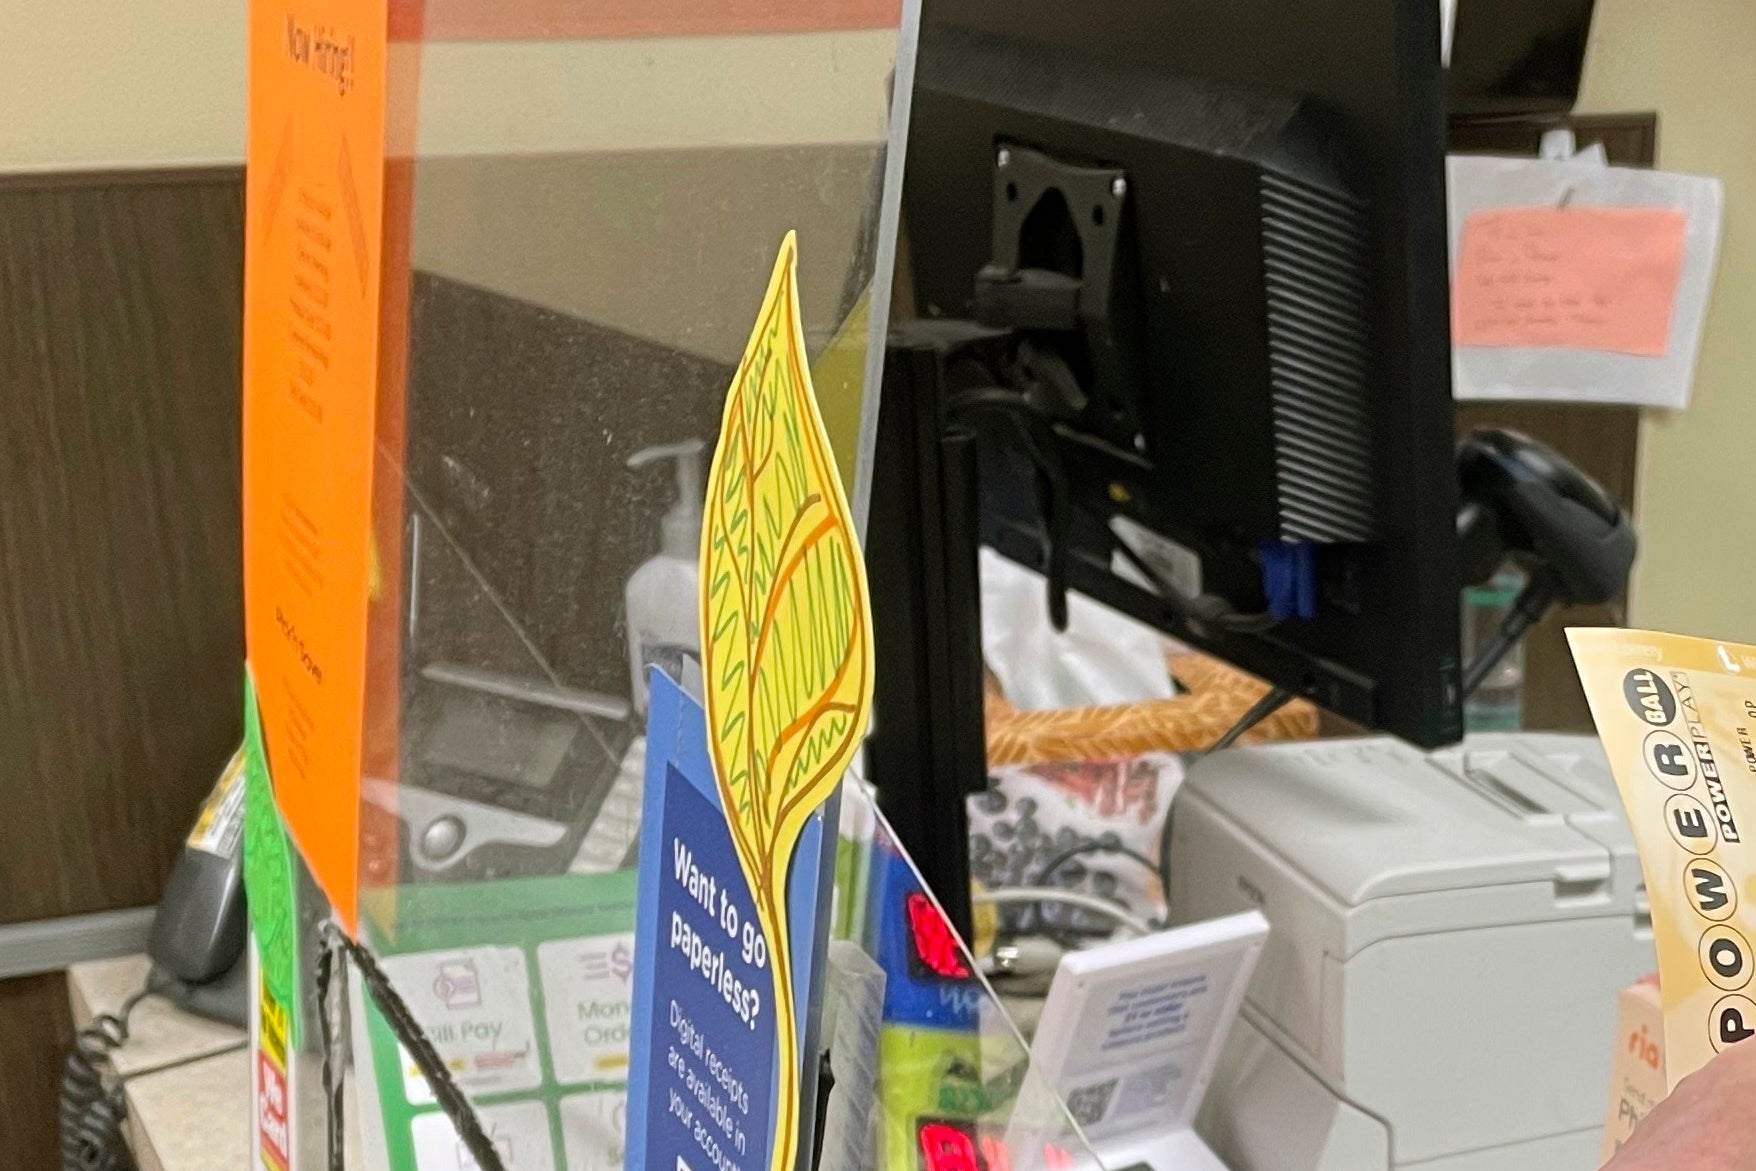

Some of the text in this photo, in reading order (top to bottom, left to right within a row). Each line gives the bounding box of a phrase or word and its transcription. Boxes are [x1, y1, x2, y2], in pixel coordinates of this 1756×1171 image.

[674, 837, 766, 969] Want to go
[577, 1001, 629, 1020] Mon
[671, 910, 760, 1030] paperless?
[461, 1021, 502, 1050] Pay
[670, 1000, 748, 1115] Digital receipts
[668, 1046, 746, 1155] are available in
[669, 1087, 692, 1128] your
